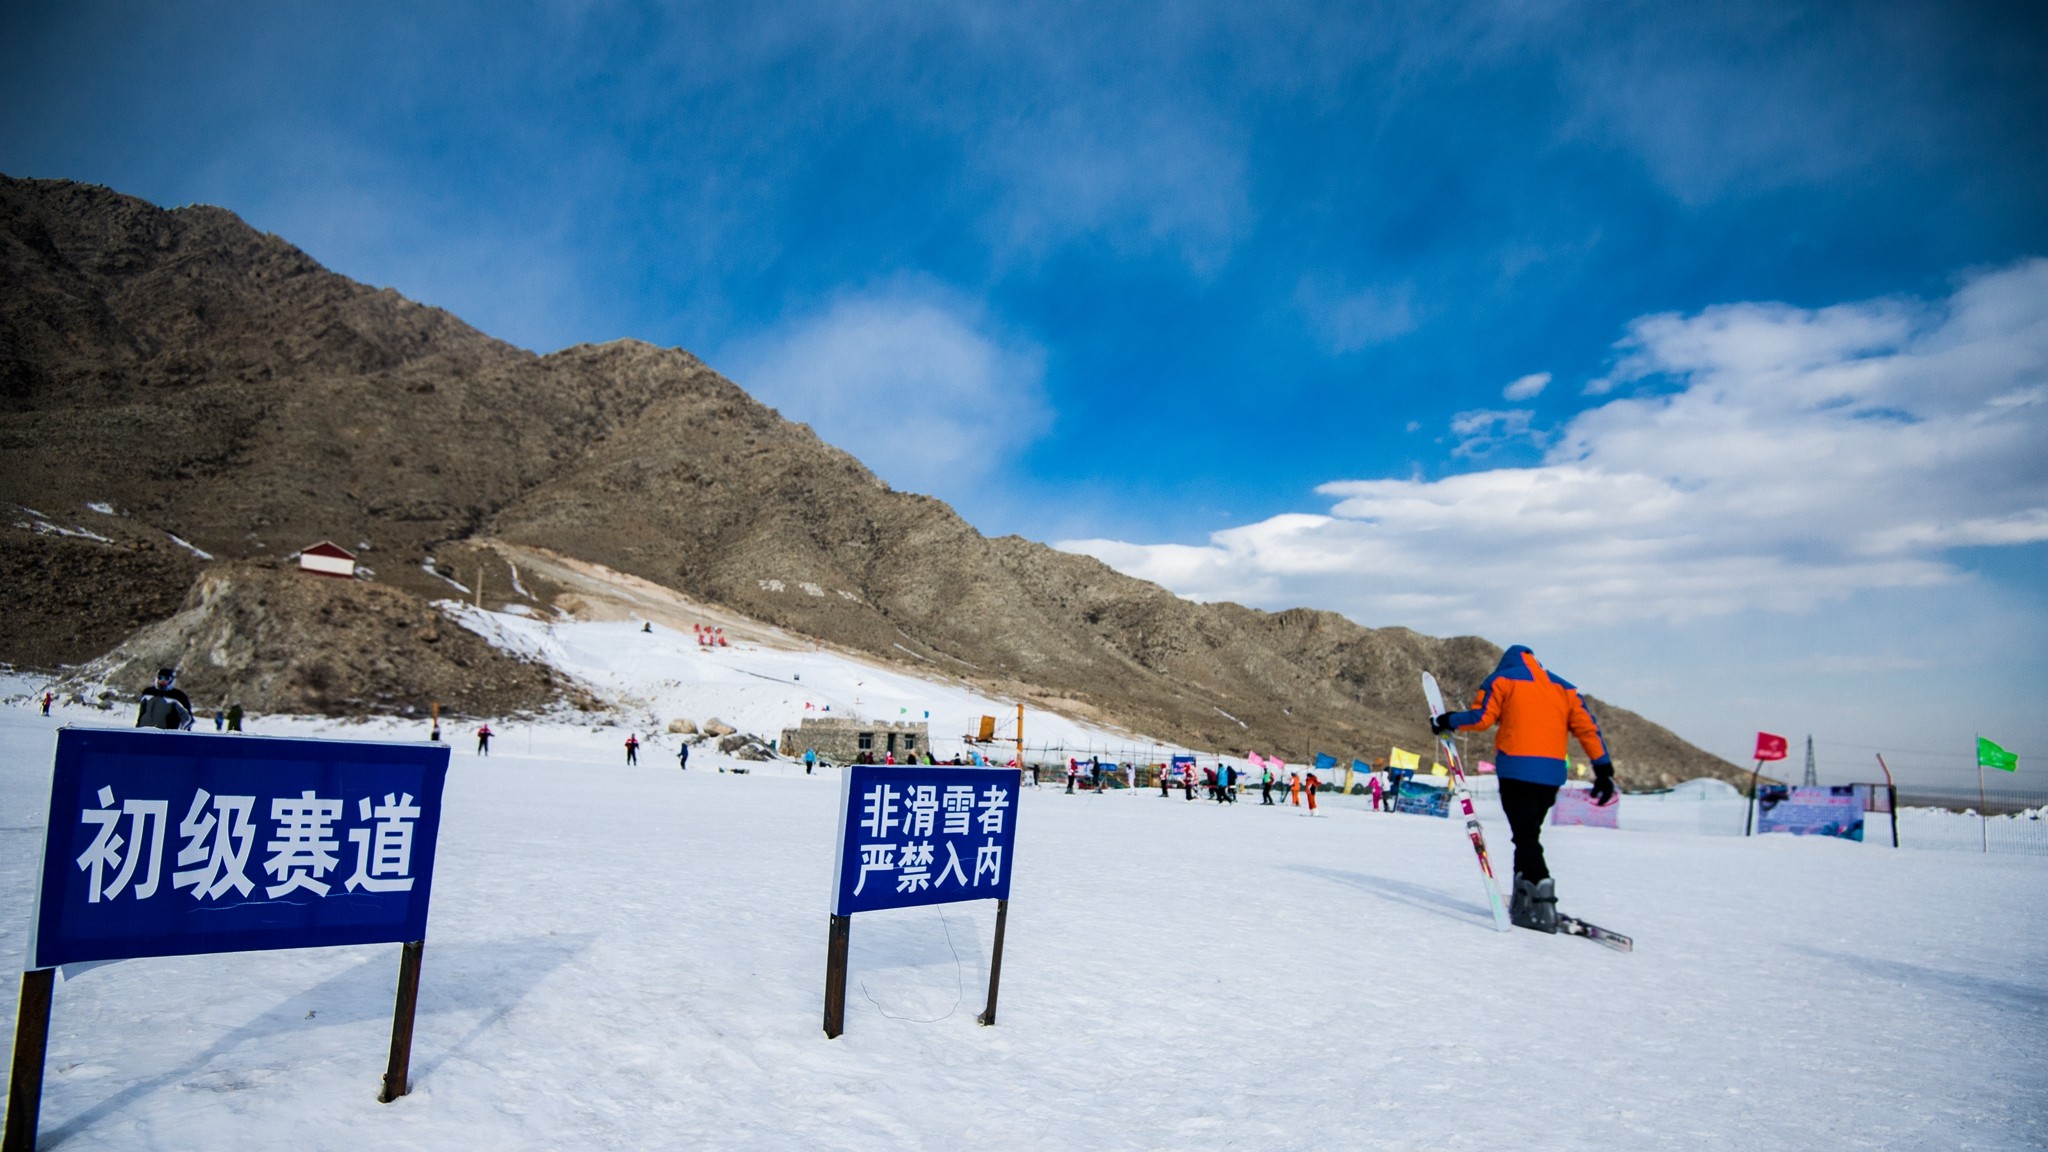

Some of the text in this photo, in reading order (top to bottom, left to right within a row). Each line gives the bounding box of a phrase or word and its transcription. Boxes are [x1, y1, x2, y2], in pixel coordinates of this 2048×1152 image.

[861, 784, 1009, 838] 非滑雪者
[77, 785, 421, 903] 初级赛道
[853, 838, 1002, 897] 严禁入内
